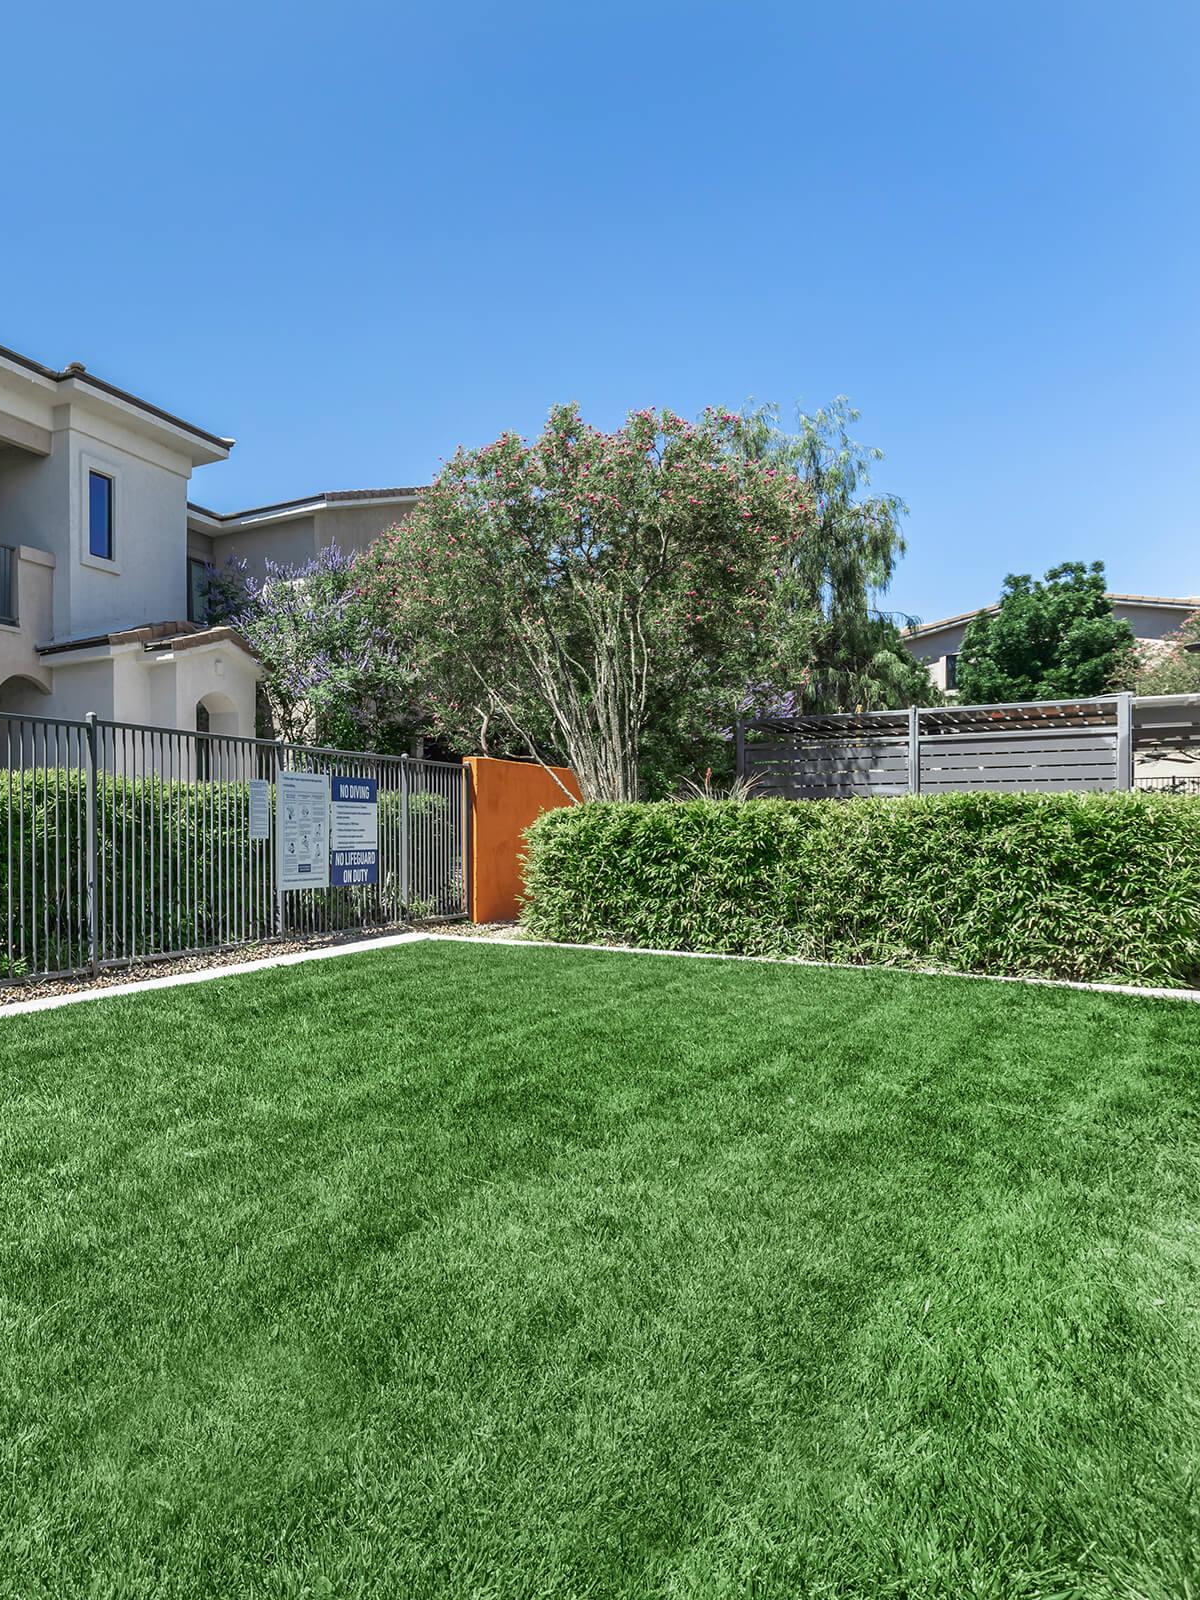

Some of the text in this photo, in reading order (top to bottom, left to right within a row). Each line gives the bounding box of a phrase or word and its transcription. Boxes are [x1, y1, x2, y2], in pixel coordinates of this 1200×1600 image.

[340, 784, 370, 800] NO DIVING
[336, 852, 344, 866] NO
[345, 852, 375, 866] LIFEGUARD
[344, 869, 368, 883] ON DUTY
